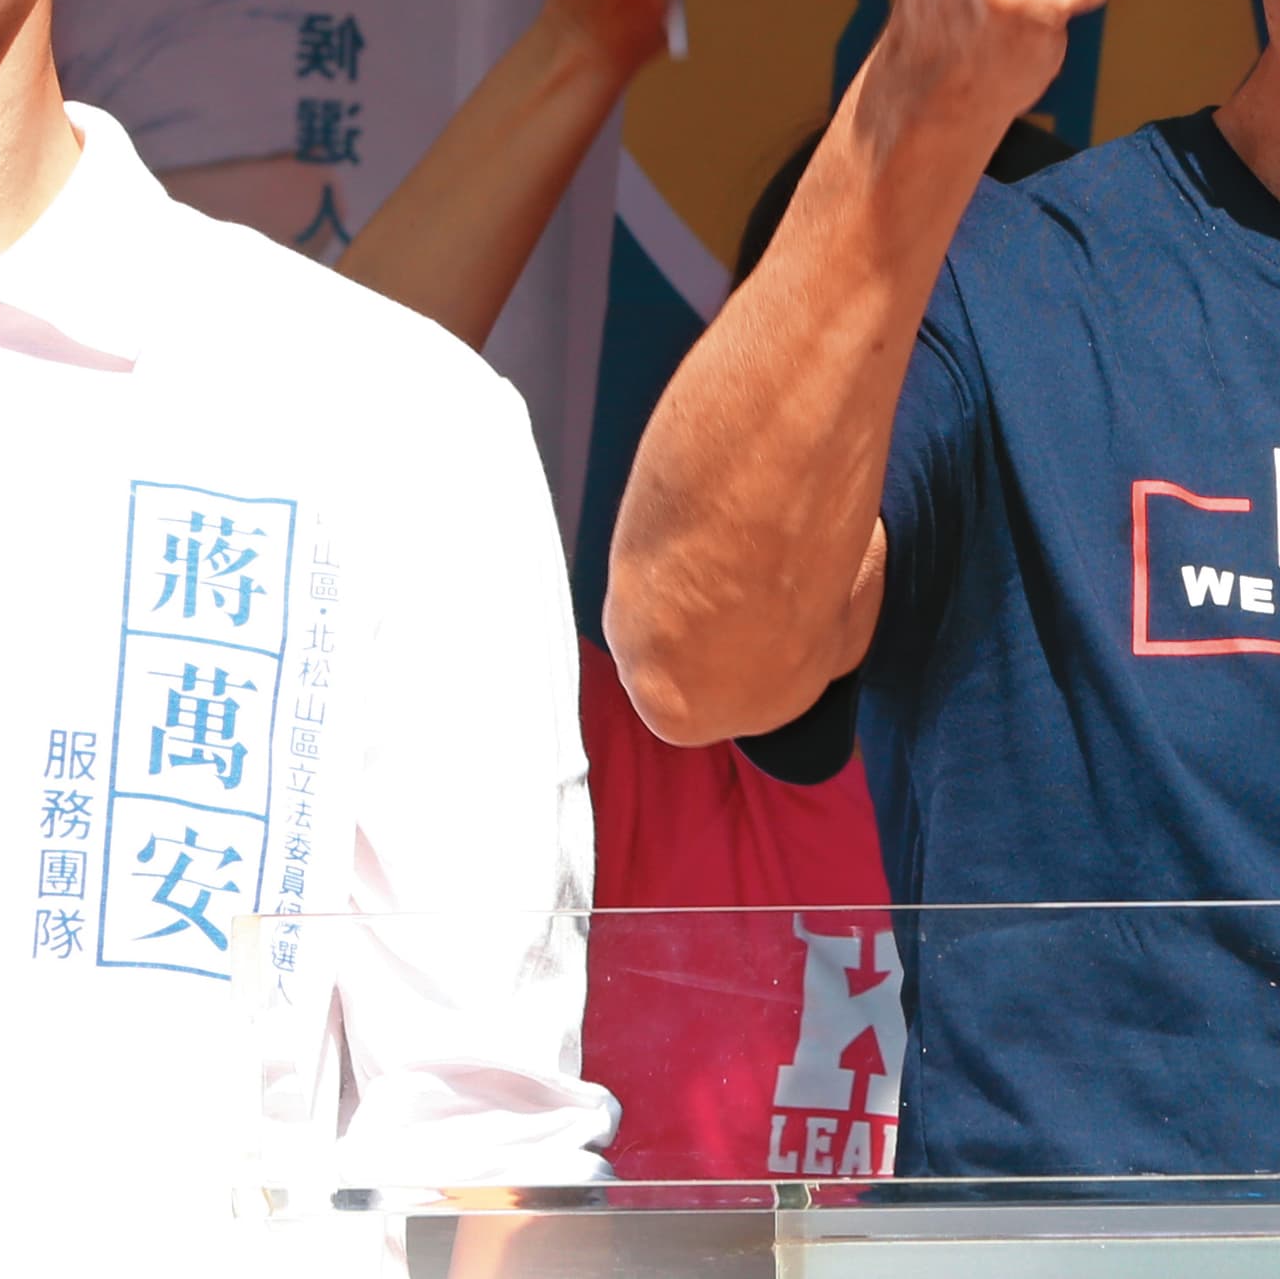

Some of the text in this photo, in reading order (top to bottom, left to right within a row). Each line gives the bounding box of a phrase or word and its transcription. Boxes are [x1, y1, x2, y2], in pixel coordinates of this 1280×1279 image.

[1181, 564, 1276, 614] WE
[31, 728, 98, 960] 服務團隊
[130, 510, 269, 952] 蔣萬安
